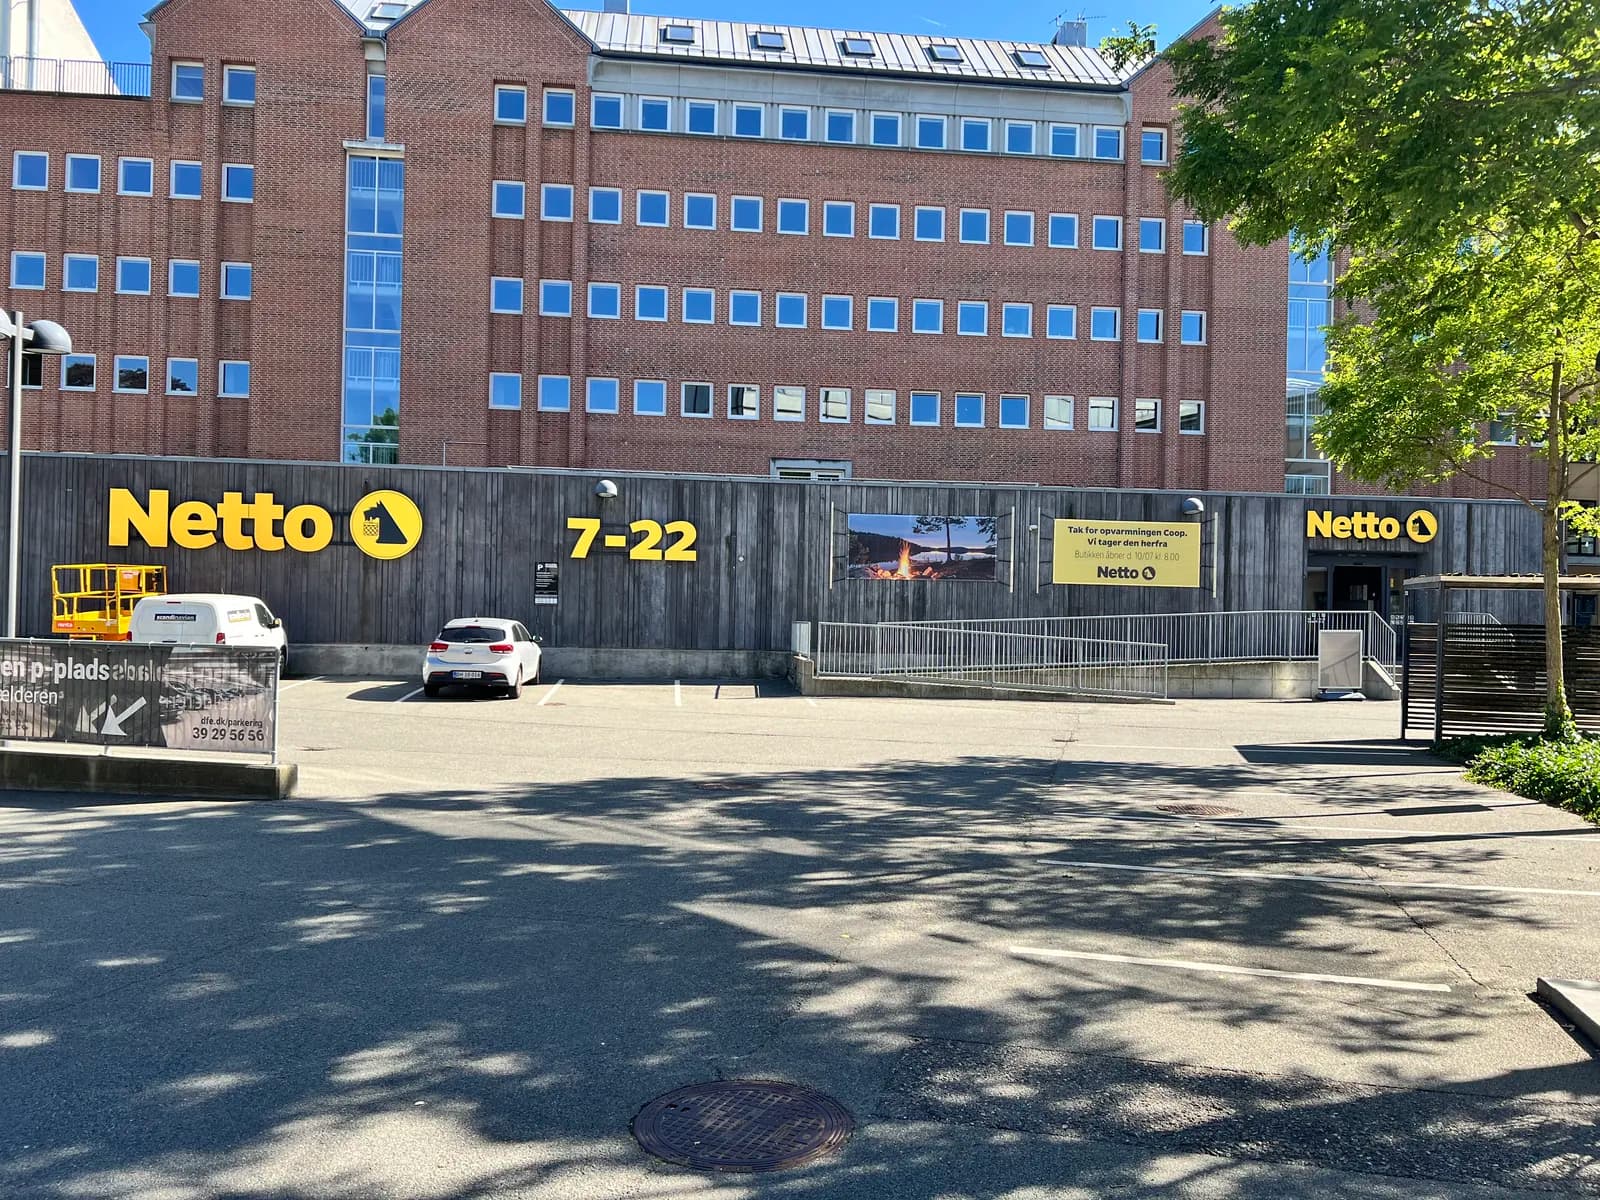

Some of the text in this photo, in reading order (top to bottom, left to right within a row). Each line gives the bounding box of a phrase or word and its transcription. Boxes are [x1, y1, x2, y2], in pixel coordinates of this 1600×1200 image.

[108, 487, 334, 553] Netto
[1306, 510, 1401, 540] Netto
[1068, 526, 1188, 538] Tak for opvarmningen Coop.
[567, 517, 697, 562] 7-22
[1087, 538, 1098, 546] Vi
[1098, 539, 1122, 548] tager
[1141, 540, 1168, 548] herfra
[1074, 551, 1104, 559] Butikken
[1105, 551, 1126, 560] åbner
[1135, 552, 1154, 561] 10/07
[1097, 566, 1139, 579] Netto
[31, 656, 110, 684] p-plads
[200, 717, 263, 728] dfe.dk/parkering
[192, 727, 265, 742] 39 29 56 56
